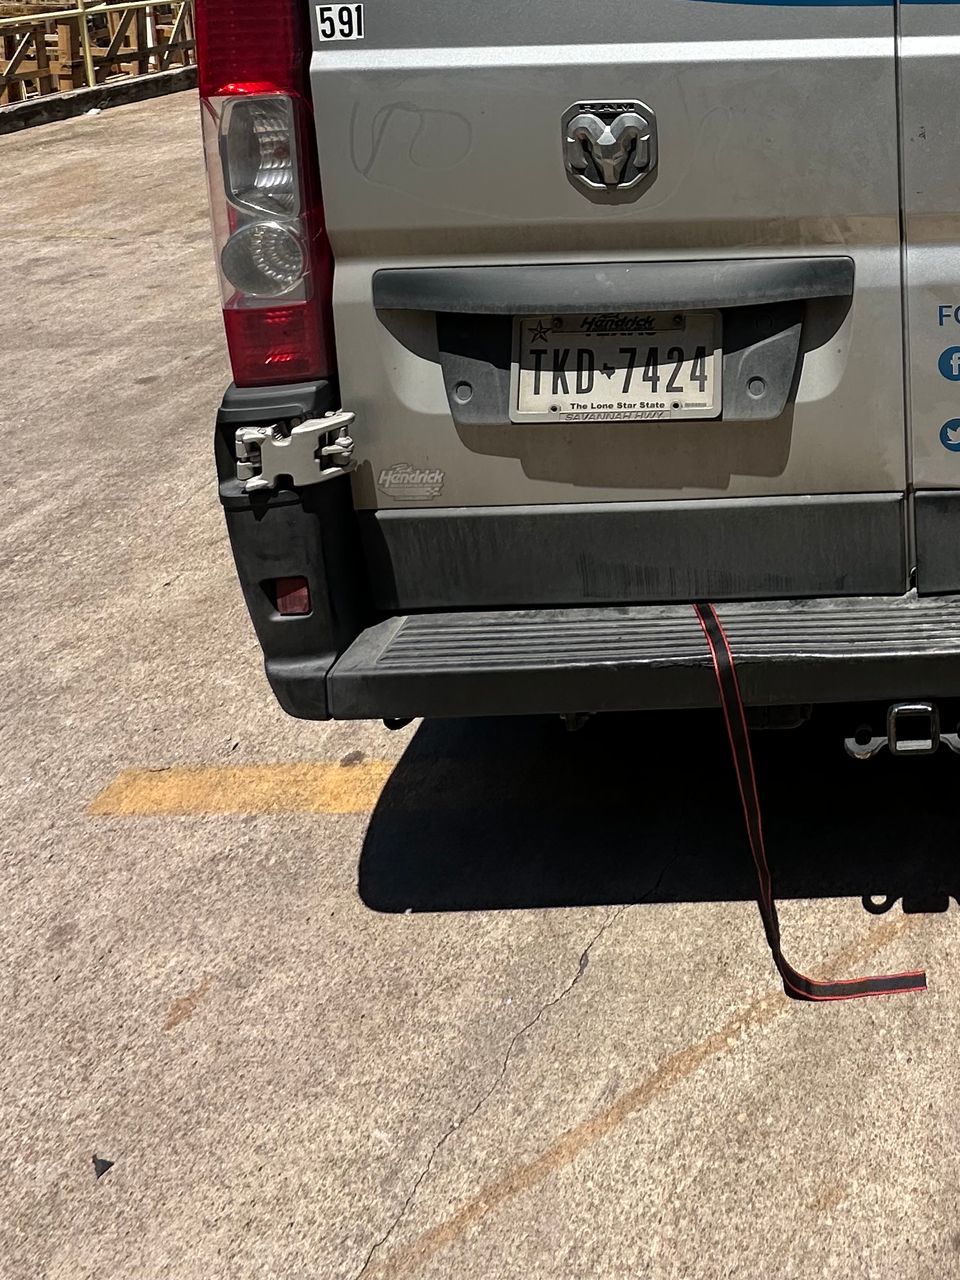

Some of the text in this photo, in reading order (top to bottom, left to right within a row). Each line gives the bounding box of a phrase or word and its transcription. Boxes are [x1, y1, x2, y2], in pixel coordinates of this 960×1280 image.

[319, 5, 363, 38] 591
[579, 104, 635, 112] RAM
[529, 346, 708, 395] TKD 7424
[570, 401, 665, 410] The Lone Star State
[378, 469, 445, 488] Hendrick
